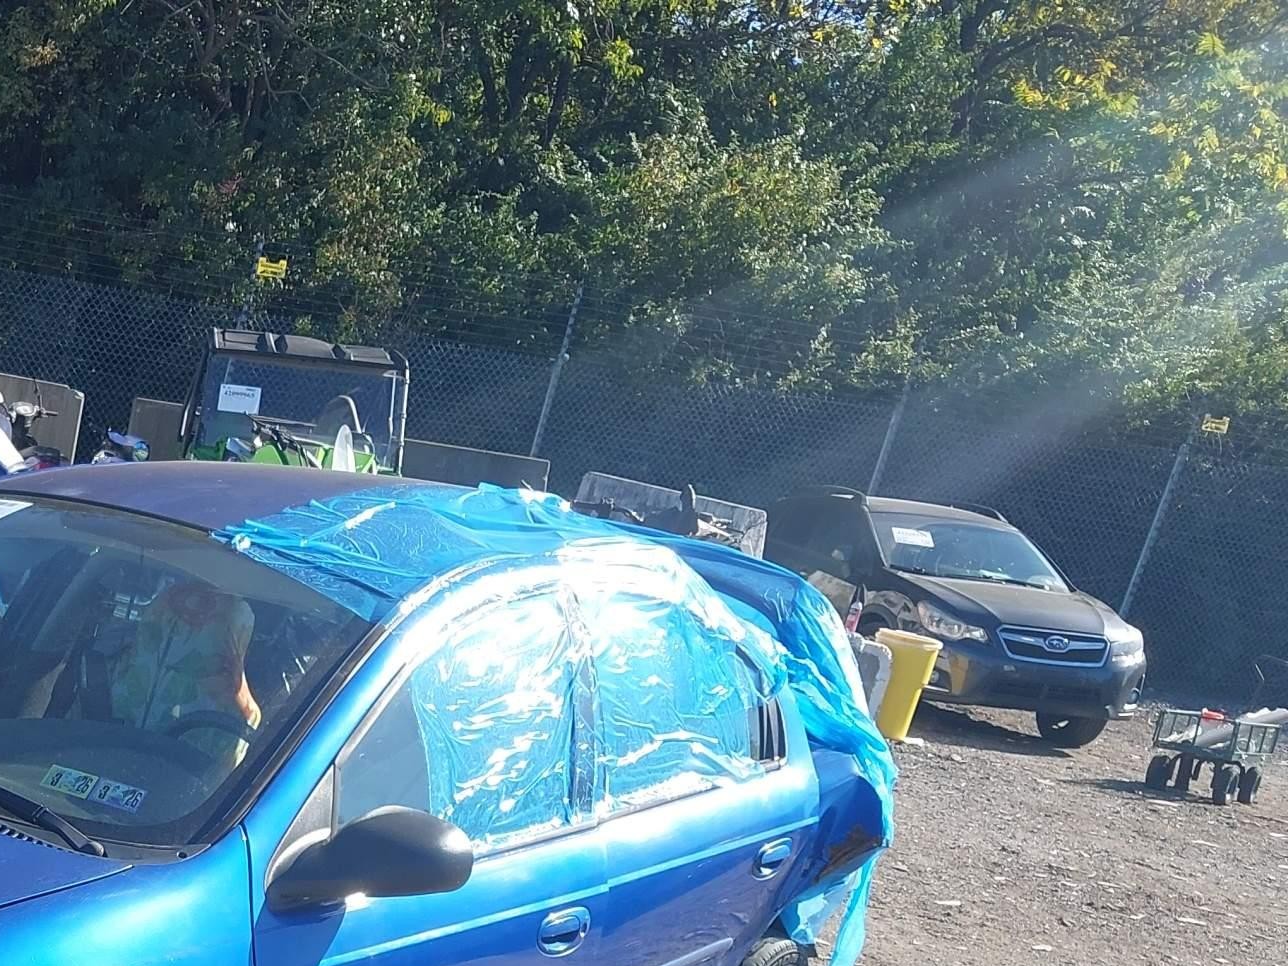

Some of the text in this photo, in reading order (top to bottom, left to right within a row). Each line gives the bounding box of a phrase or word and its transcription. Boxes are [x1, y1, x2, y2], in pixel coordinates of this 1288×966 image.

[51, 773, 93, 794] 3 26
[99, 785, 143, 809] 3 26
